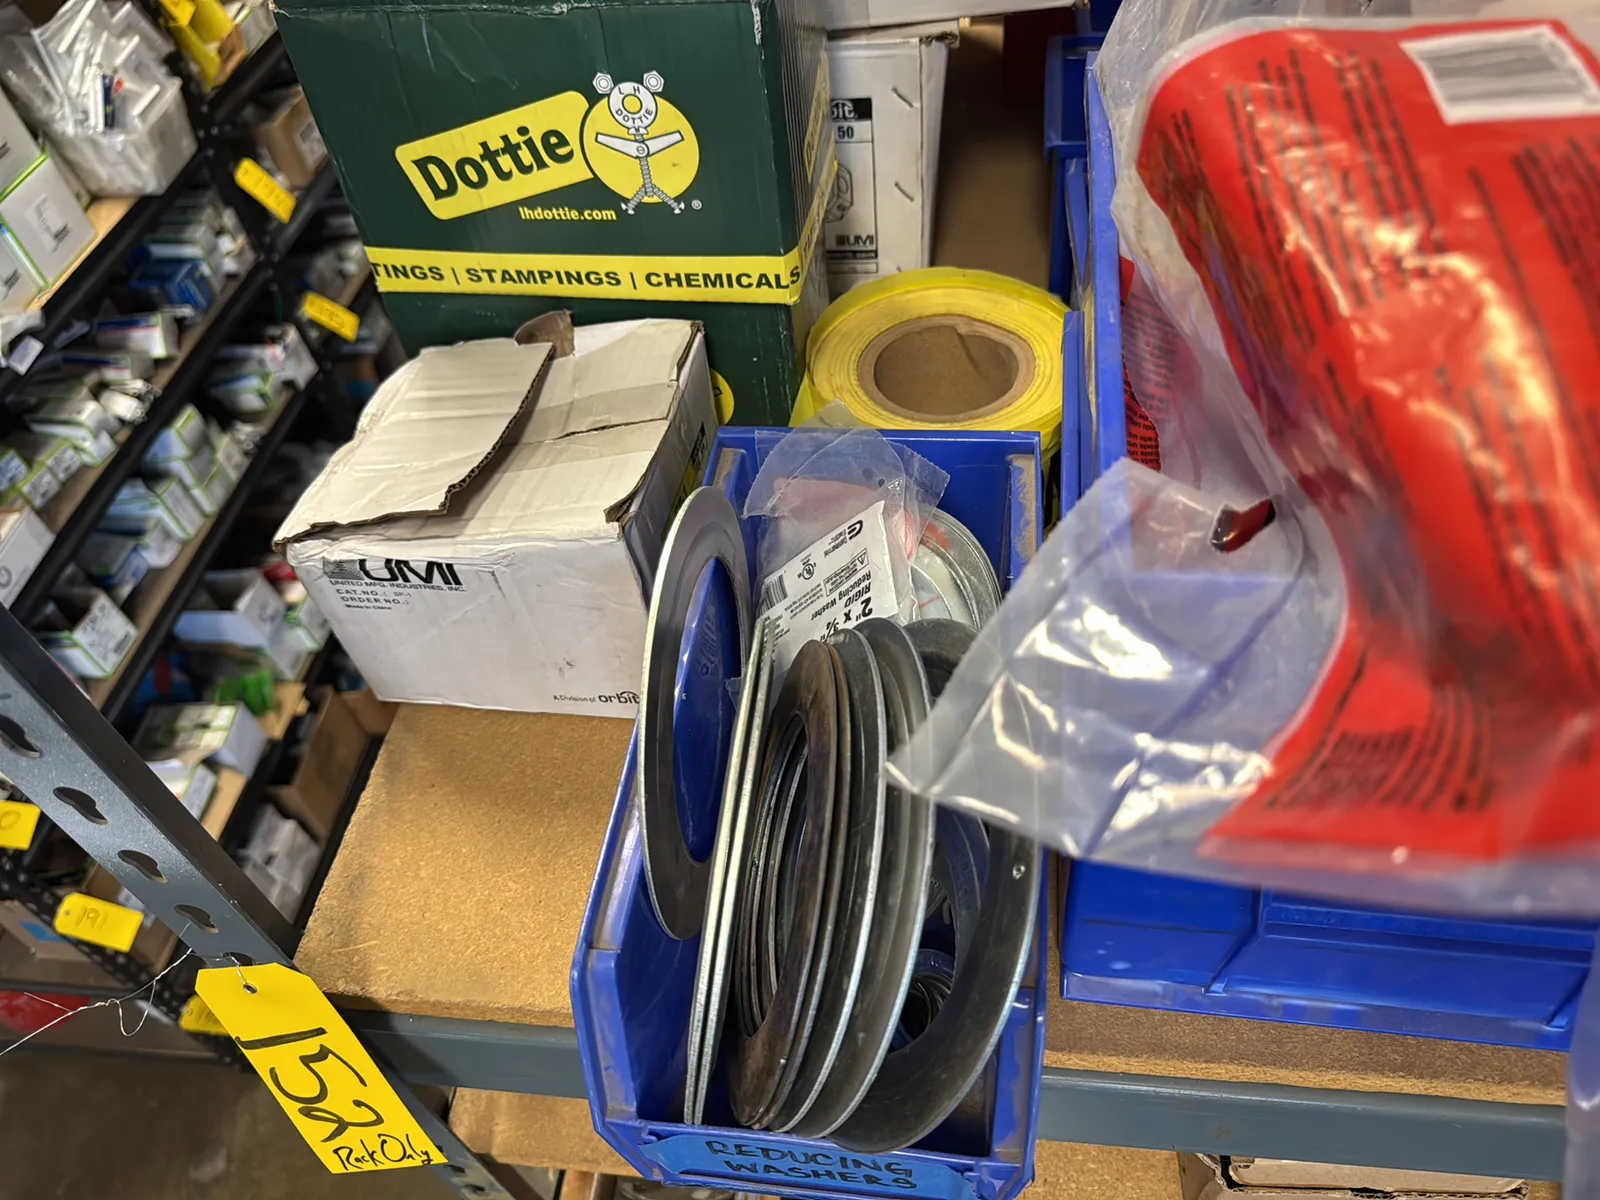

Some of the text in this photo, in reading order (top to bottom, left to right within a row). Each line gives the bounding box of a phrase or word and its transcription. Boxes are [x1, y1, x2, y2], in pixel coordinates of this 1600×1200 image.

[615, 108, 653, 125] DOTTIE
[837, 125, 854, 139] 50
[411, 126, 574, 200] Dottie
[519, 206, 617, 222] lhdottie.com
[468, 268, 621, 288] STAMPINGS
[645, 265, 801, 290] CHEMICALS
[329, 579, 363, 587] UNITED
[838, 570, 872, 601] Reducing
[844, 582, 872, 609] RIGID
[341, 596, 382, 604] ORDER
[810, 594, 837, 621] Washer
[855, 596, 873, 622] 2"
[235, 1027, 385, 1143] 152
[333, 1140, 379, 1171] Rack
[705, 1140, 913, 1178] REDUCING
[723, 1160, 918, 1190] WASHERS
